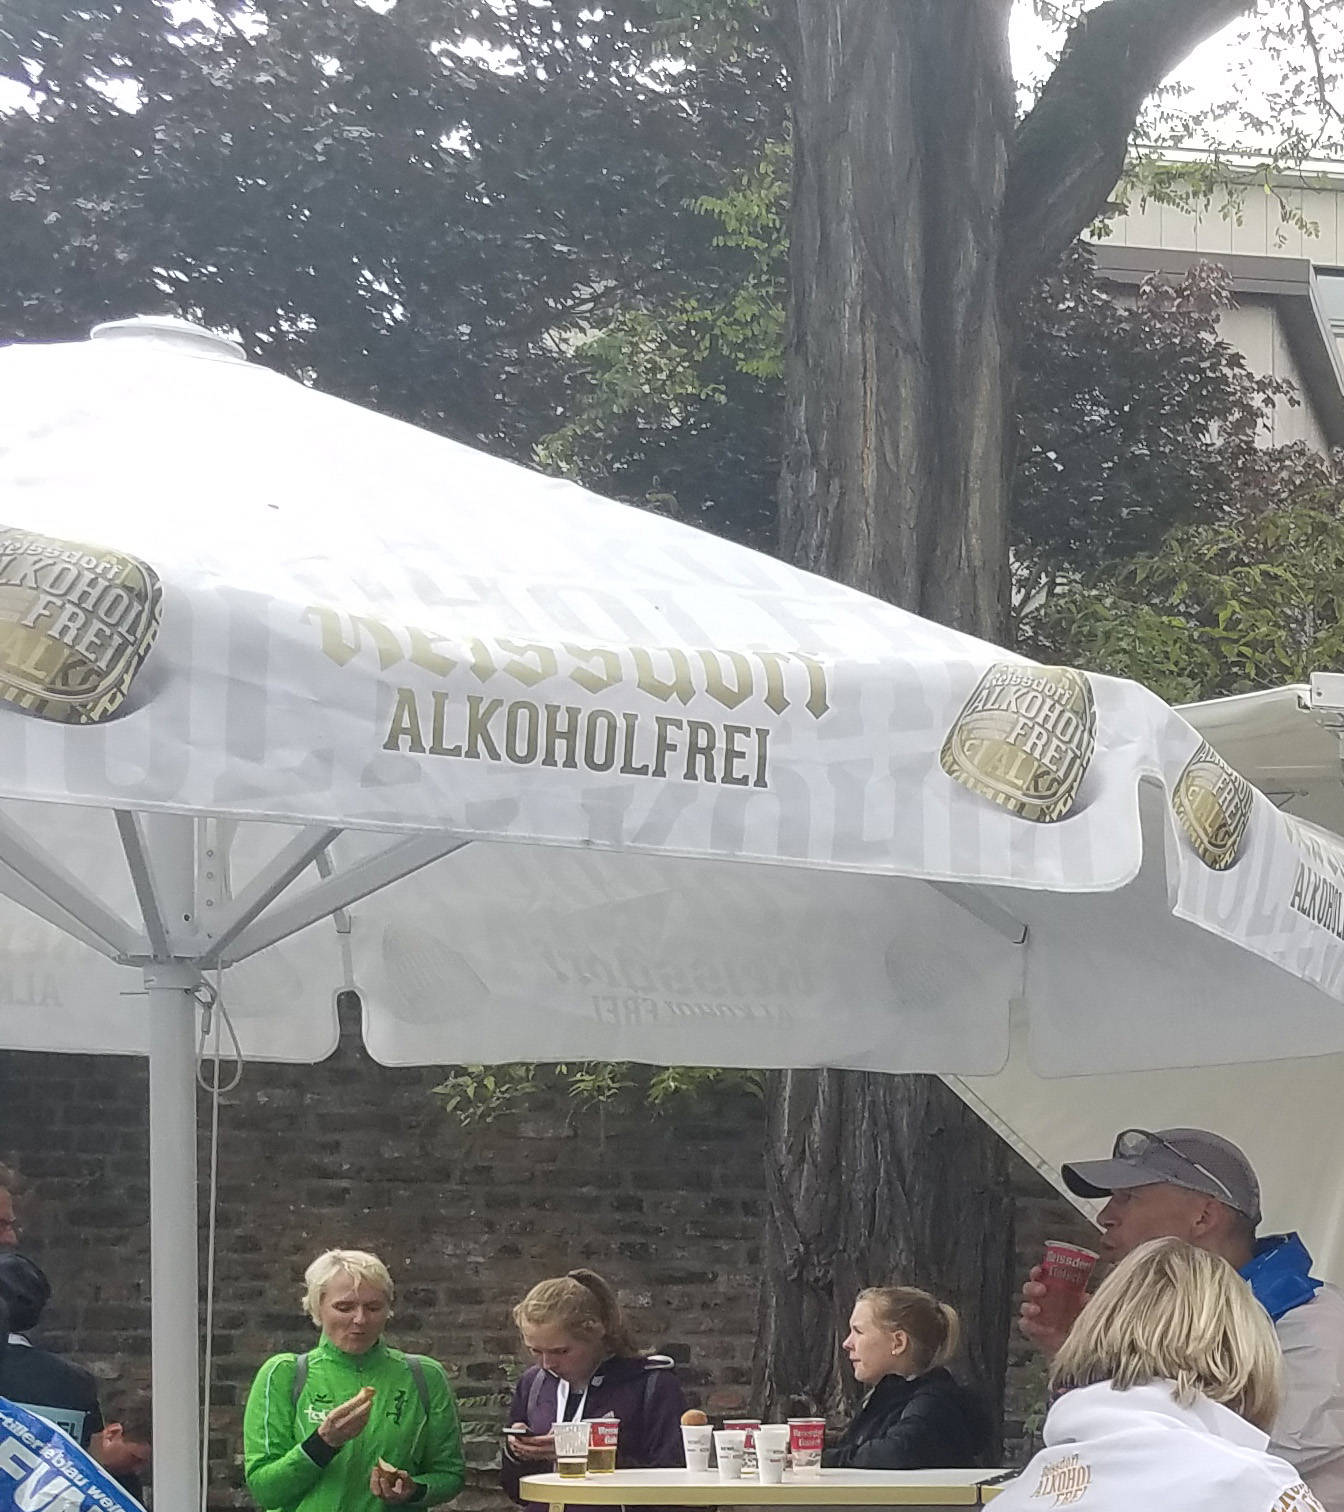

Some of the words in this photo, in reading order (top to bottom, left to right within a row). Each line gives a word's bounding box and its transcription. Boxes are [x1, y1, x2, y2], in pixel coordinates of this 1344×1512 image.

[0, 556, 142, 645] LKOHOL
[20, 599, 124, 672] FREI
[382, 687, 770, 789] ALKOHOLFREI
[968, 687, 1086, 757] ALKOHOL
[1006, 716, 1077, 780] FREI
